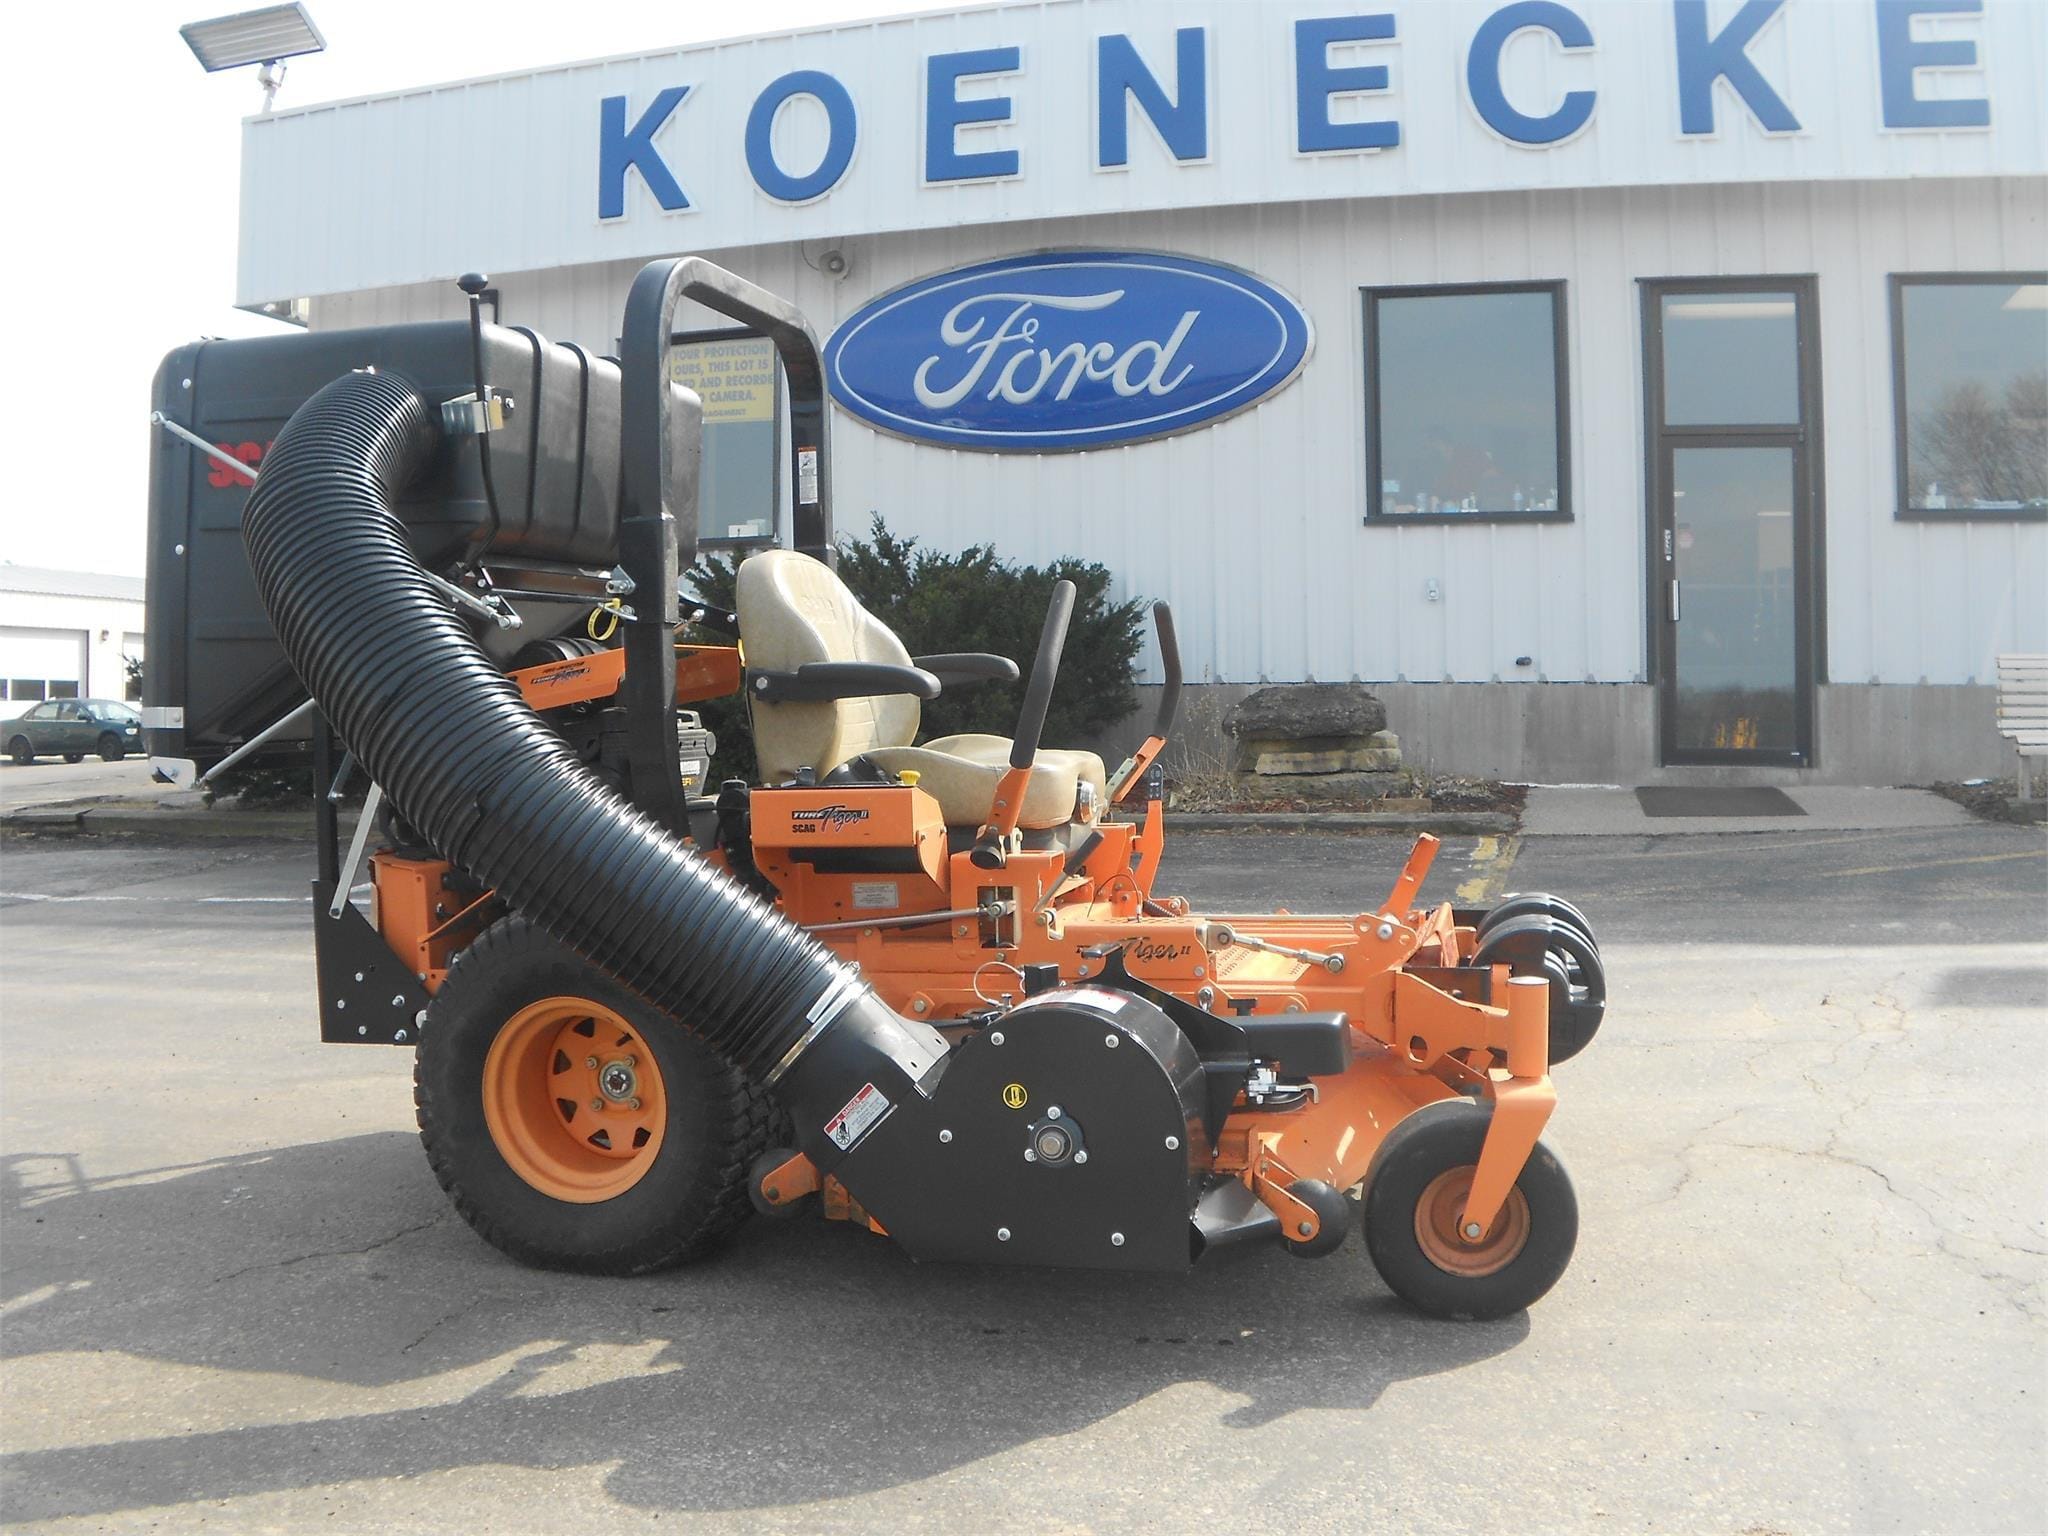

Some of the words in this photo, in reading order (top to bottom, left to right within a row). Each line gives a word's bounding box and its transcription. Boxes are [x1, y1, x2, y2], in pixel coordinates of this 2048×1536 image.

[599, 0, 1991, 219] KOENECKE
[704, 345, 768, 358] PROTECTION
[913, 289, 1201, 409] Ford
[708, 361, 731, 373] THIS
[735, 359, 754, 371] LOT
[758, 358, 769, 370] IS
[700, 377, 721, 388] AND
[709, 390, 757, 403] CAMERA.
[208, 441, 273, 488] SC
[792, 811, 825, 820] TURF
[817, 804, 862, 833] Tiger
[792, 824, 816, 833] SCAG
[1119, 936, 1179, 963] Tiger
[1179, 945, 1192, 955] II
[841, 1097, 861, 1117] DANGER
